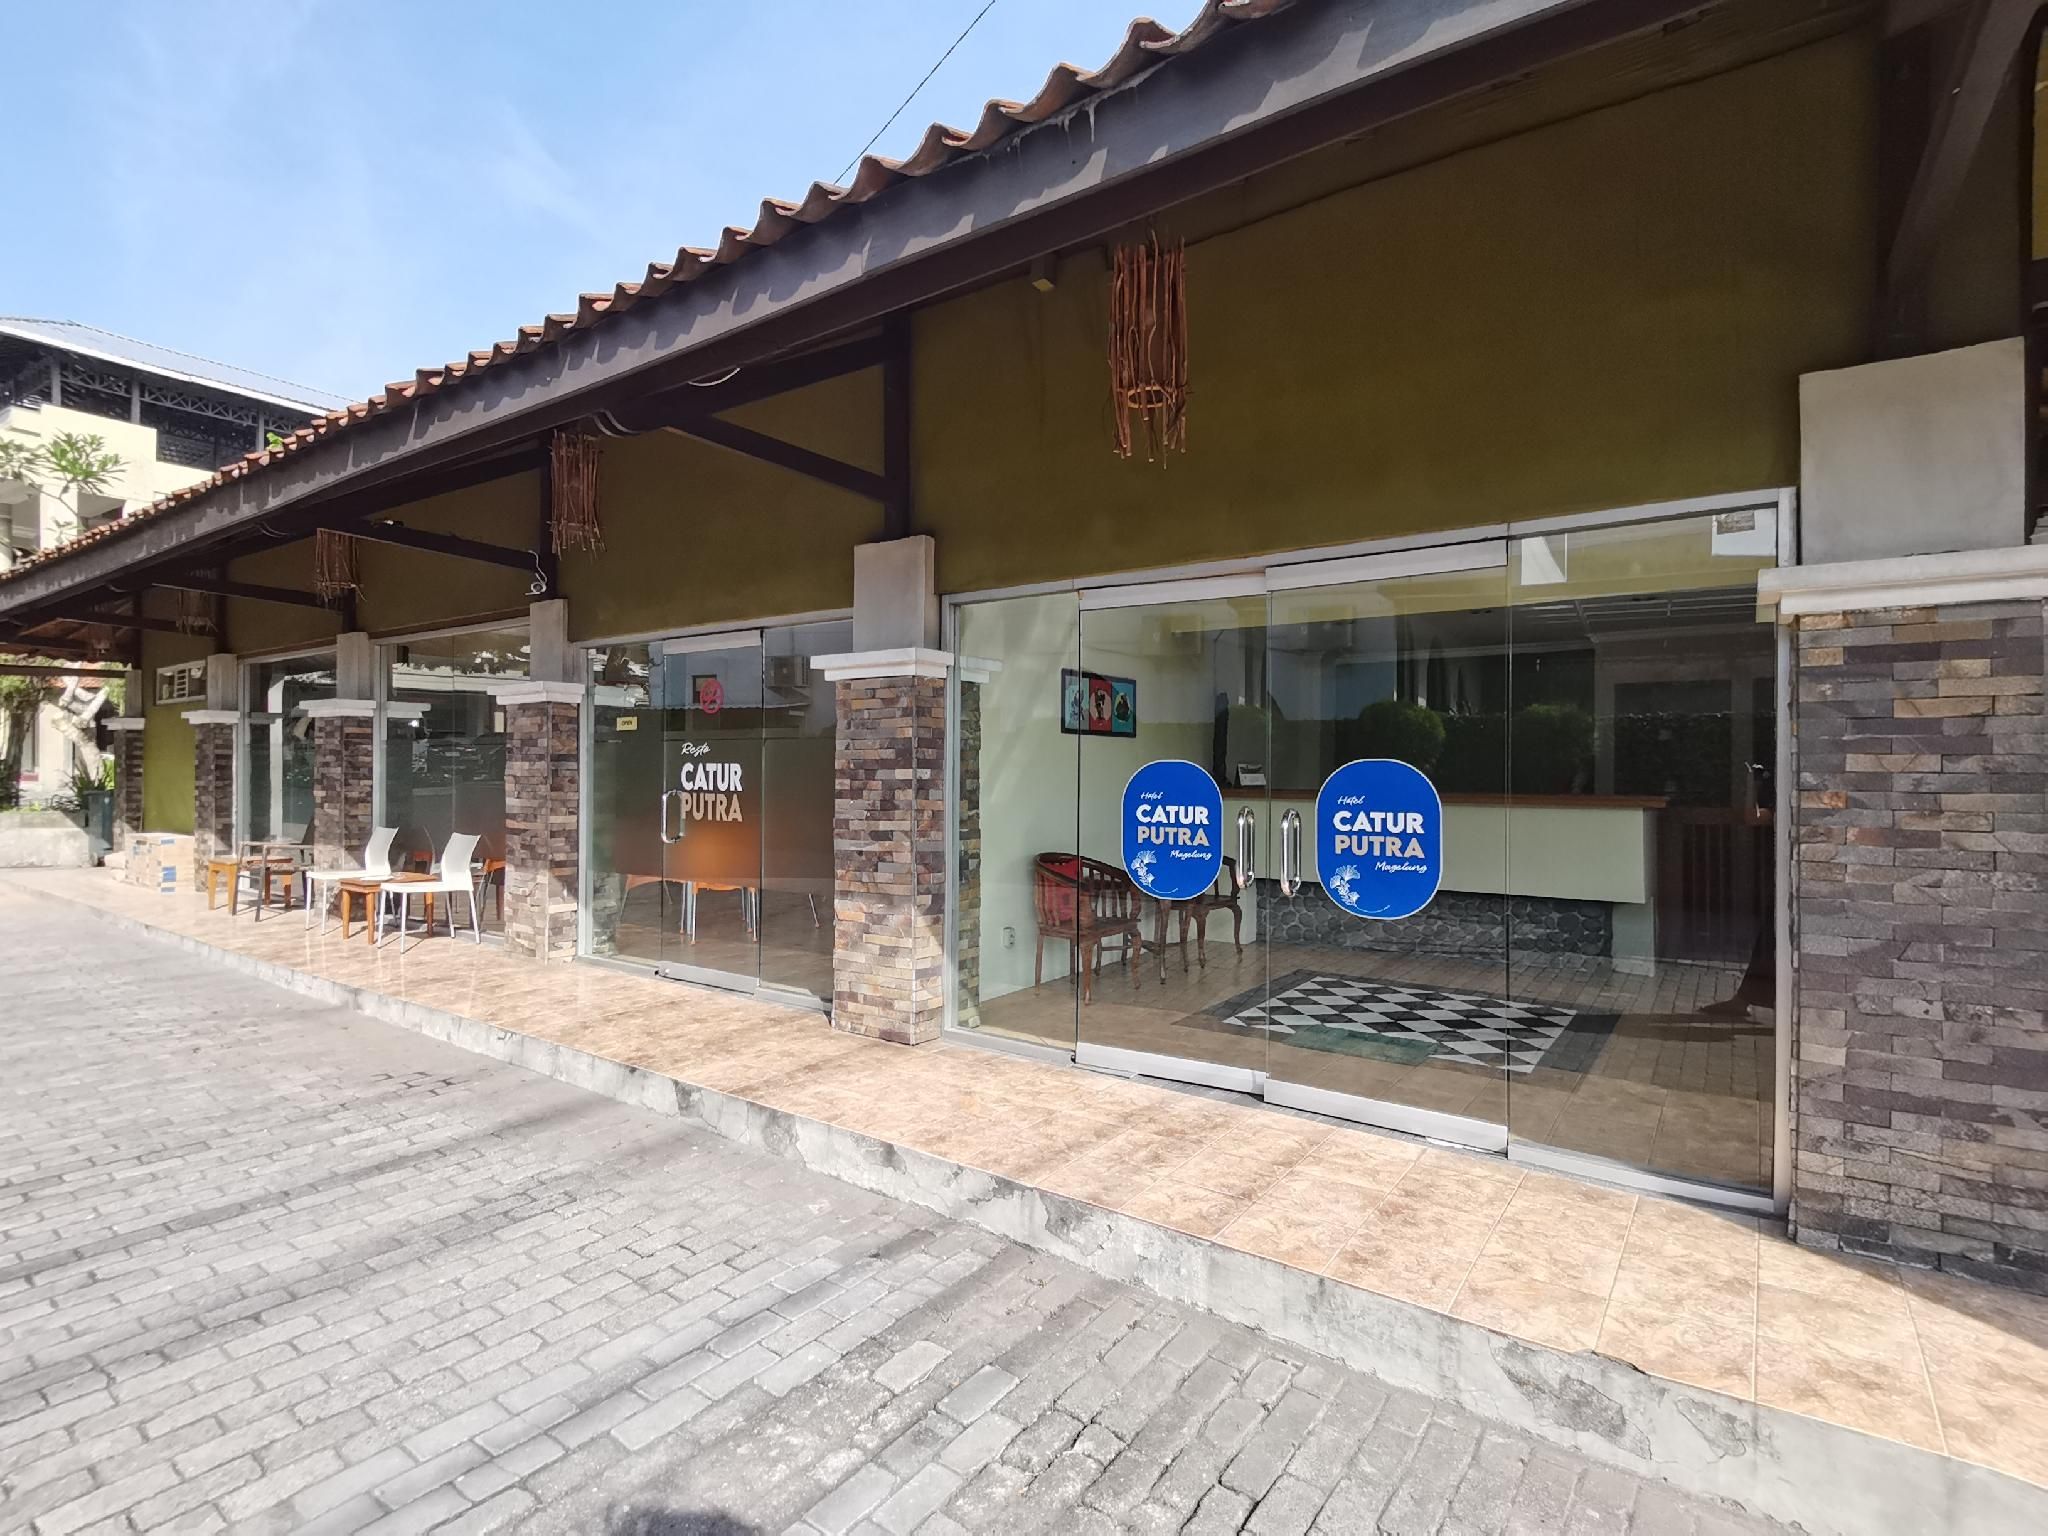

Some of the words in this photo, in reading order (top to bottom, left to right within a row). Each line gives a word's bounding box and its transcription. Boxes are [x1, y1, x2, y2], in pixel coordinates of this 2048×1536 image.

[681, 742, 711, 757] Resto
[681, 762, 742, 791] CATUR
[1140, 791, 1163, 800] Hotel
[1337, 795, 1365, 806] Hotel
[681, 791, 742, 822] PUTRA
[1136, 804, 1209, 825] CATUR
[1332, 810, 1425, 834] CATUR
[1137, 826, 1210, 846] PUTRA
[1334, 835, 1425, 858] PUTRA
